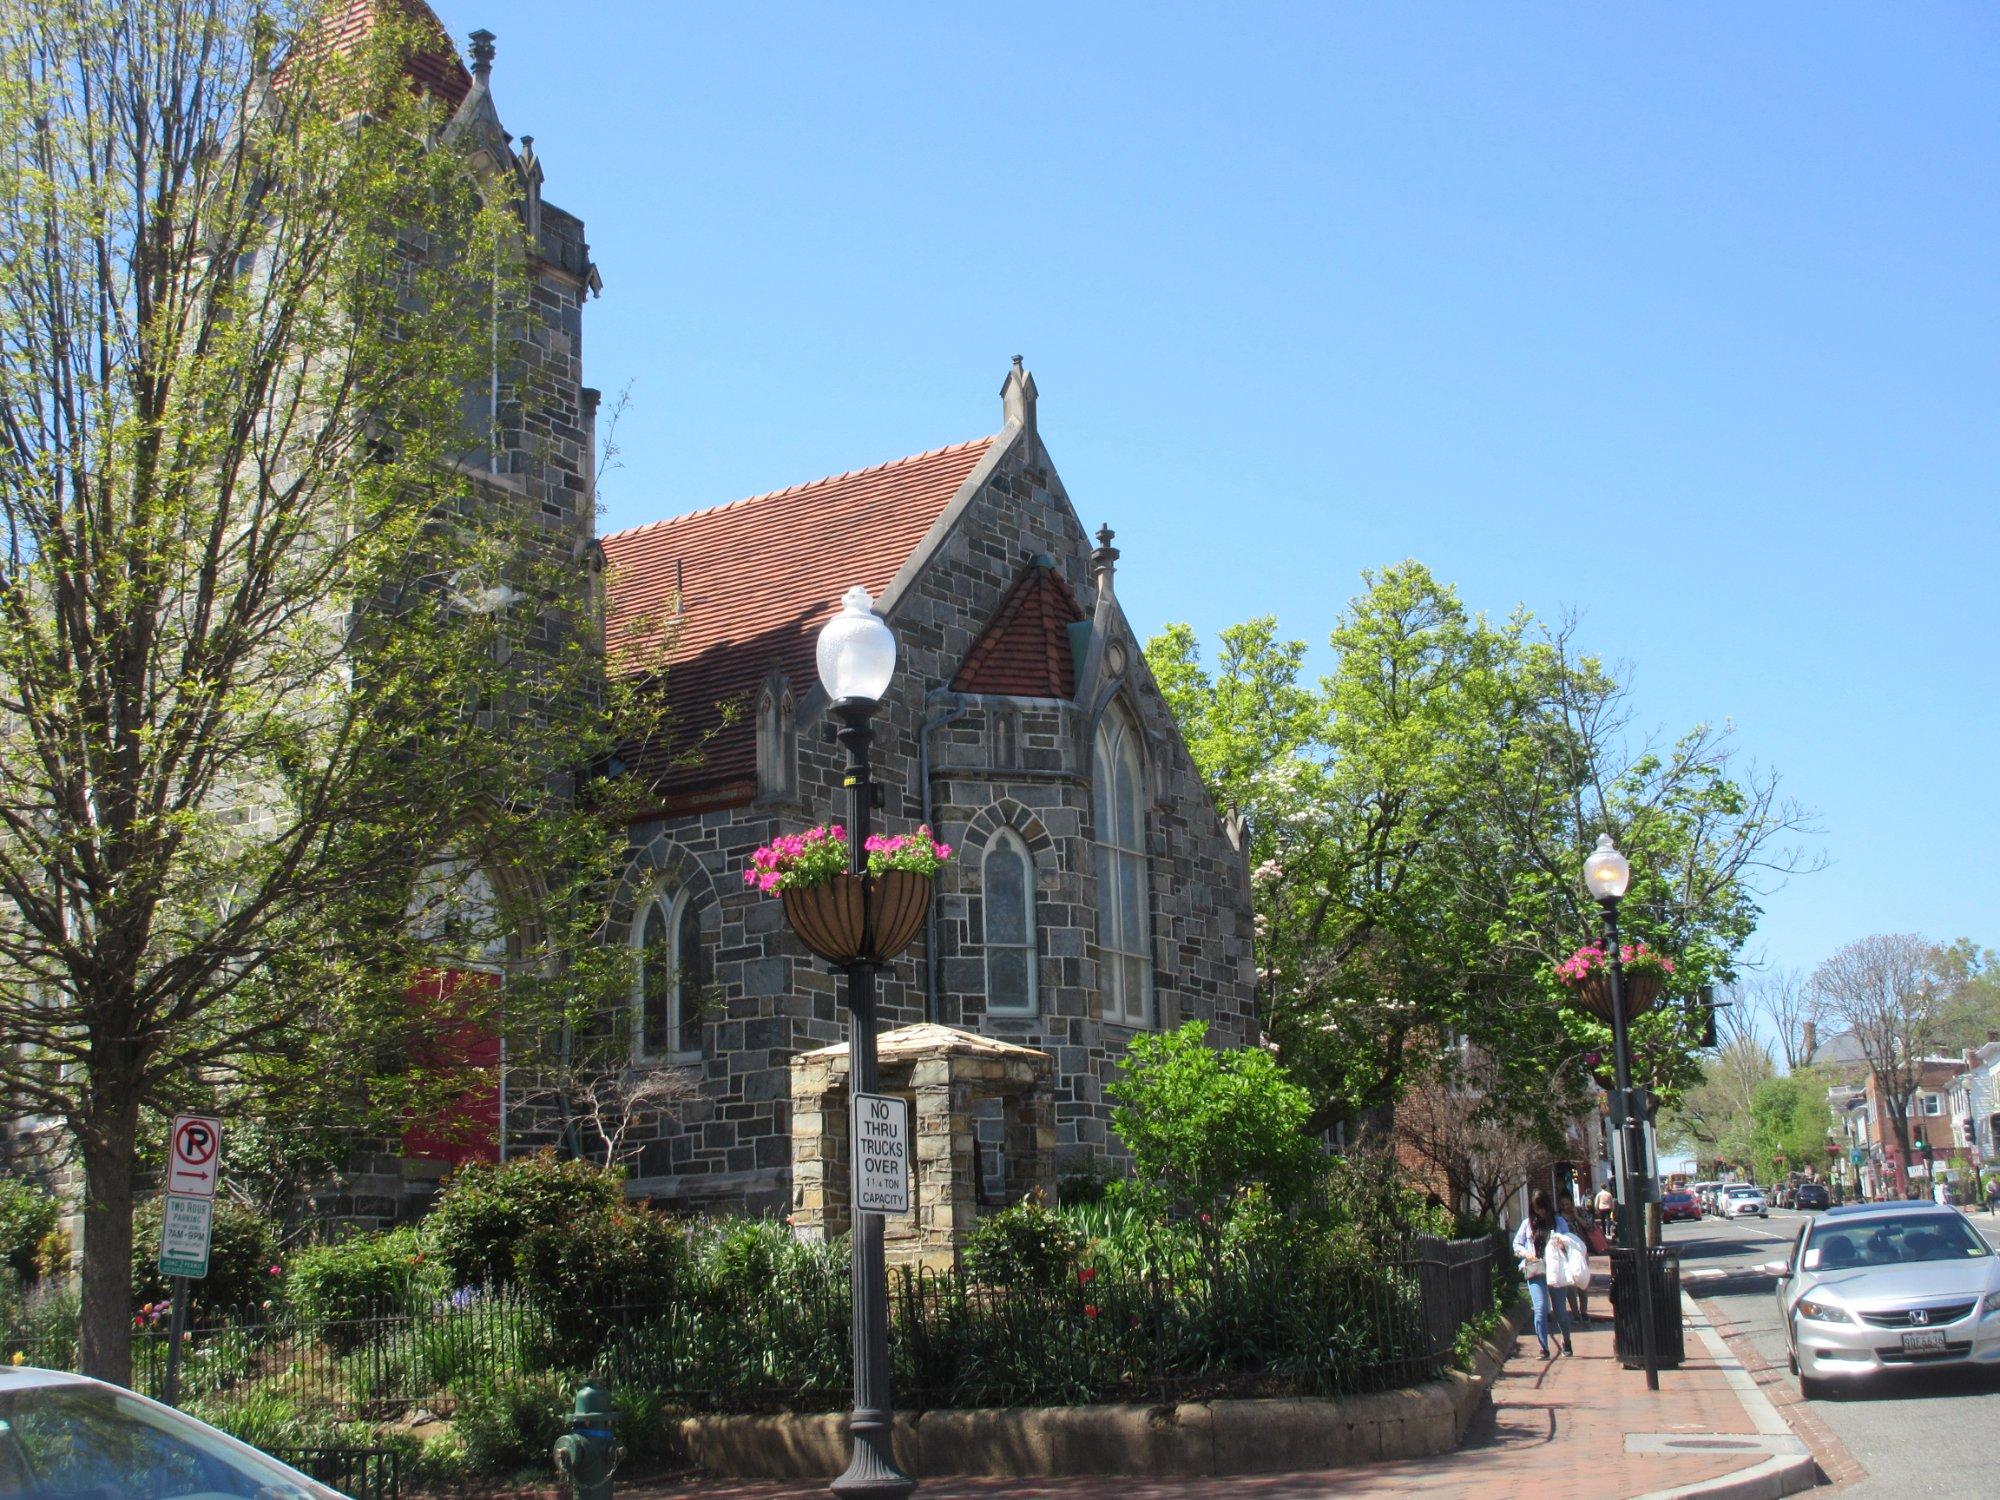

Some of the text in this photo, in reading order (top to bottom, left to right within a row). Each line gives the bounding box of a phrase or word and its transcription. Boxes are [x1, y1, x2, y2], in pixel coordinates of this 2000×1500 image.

[871, 1102, 889, 1120] NO
[864, 1121, 897, 1138] THRU
[861, 1138, 903, 1158] TRUCKS
[865, 1158, 898, 1175] OVER
[884, 1179, 899, 1189] TON
[863, 1192, 903, 1205] CAPACITY
[171, 1201, 206, 1214] TWO HOUR
[173, 1213, 201, 1224] PARKING
